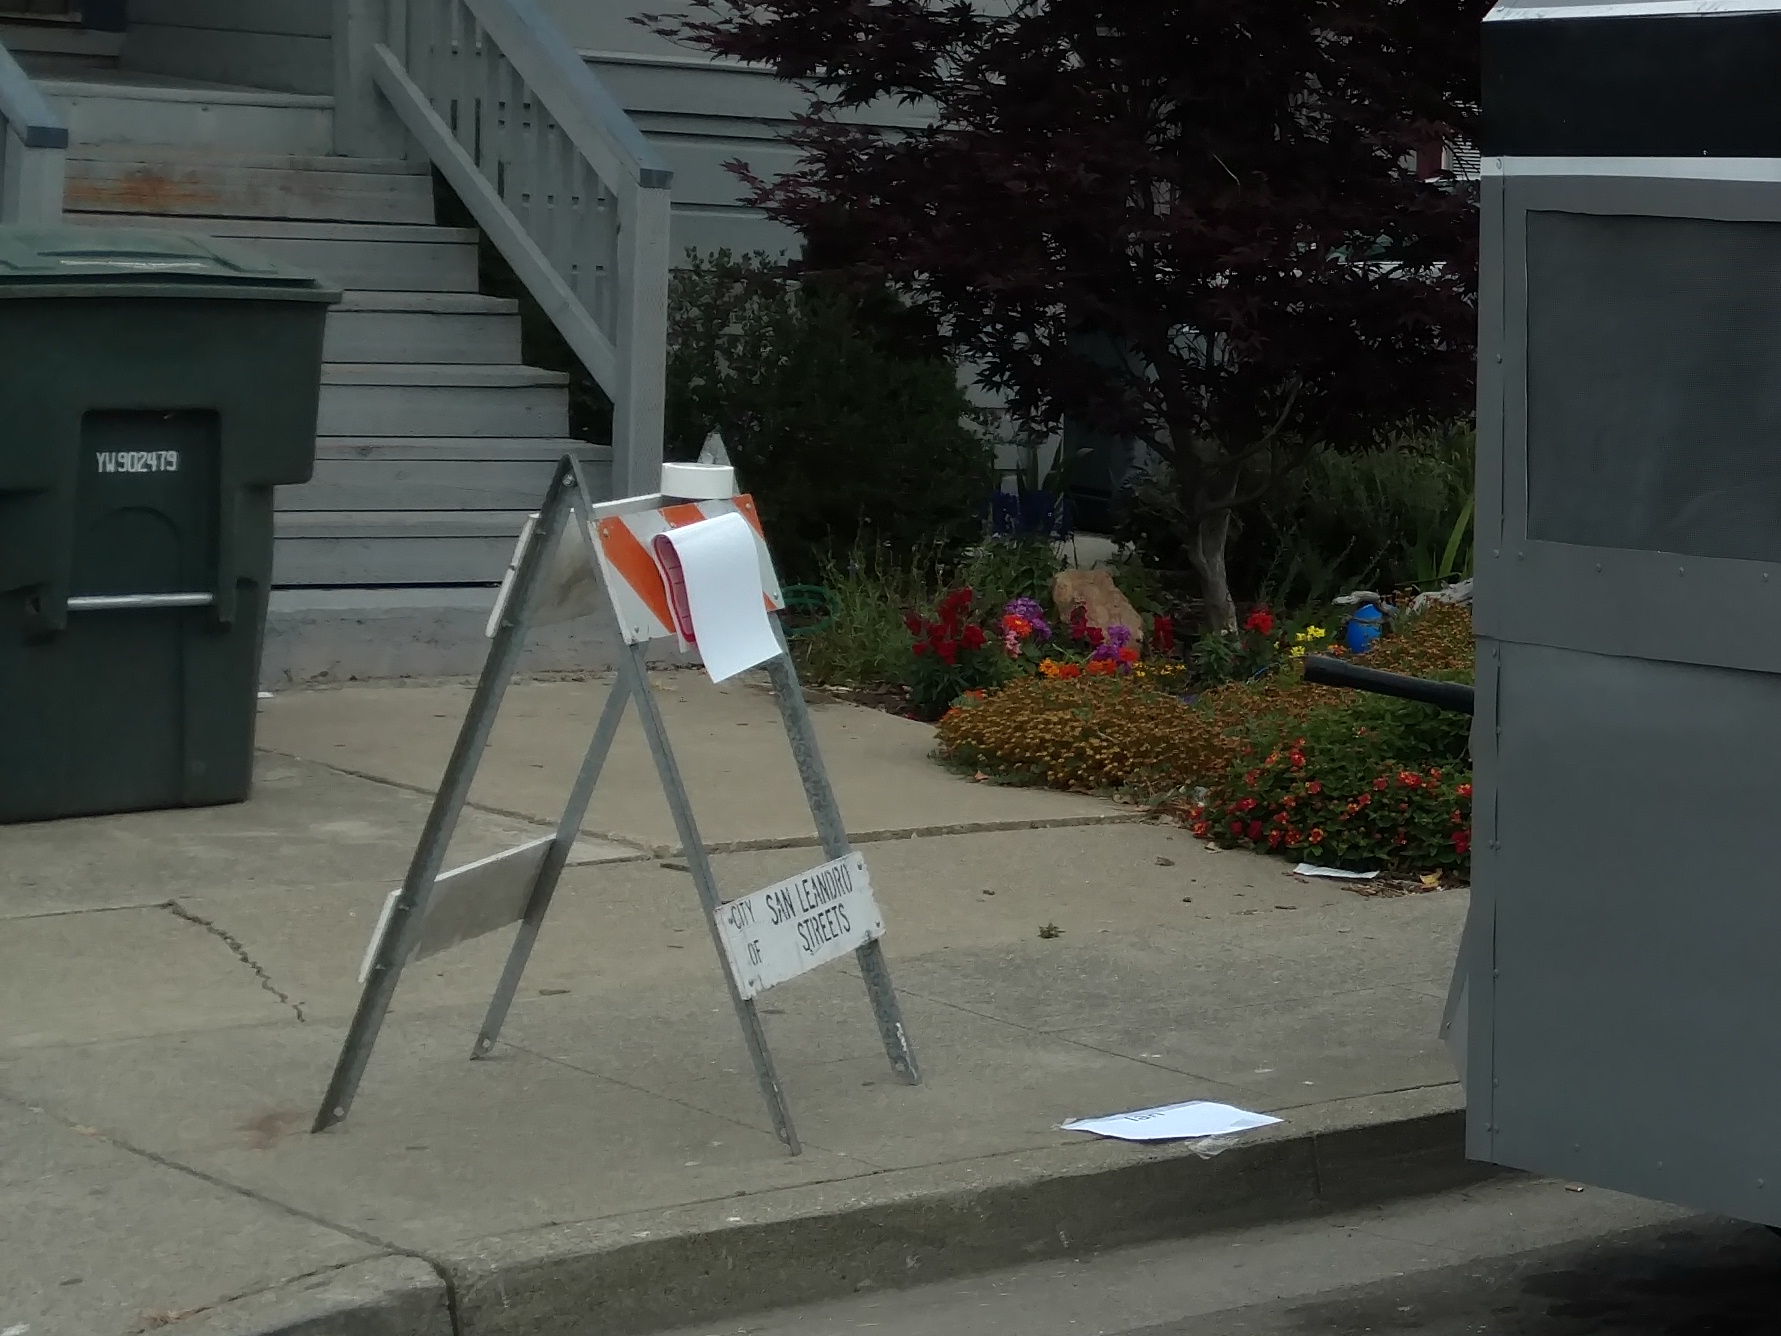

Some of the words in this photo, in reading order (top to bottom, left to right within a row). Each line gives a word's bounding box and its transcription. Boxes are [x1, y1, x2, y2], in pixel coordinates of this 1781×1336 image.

[730, 899, 756, 930] CITY
[765, 887, 797, 926] SAN
[795, 864, 853, 914] LEANDRO
[797, 902, 851, 952] STREETS
[747, 939, 763, 966] OF
